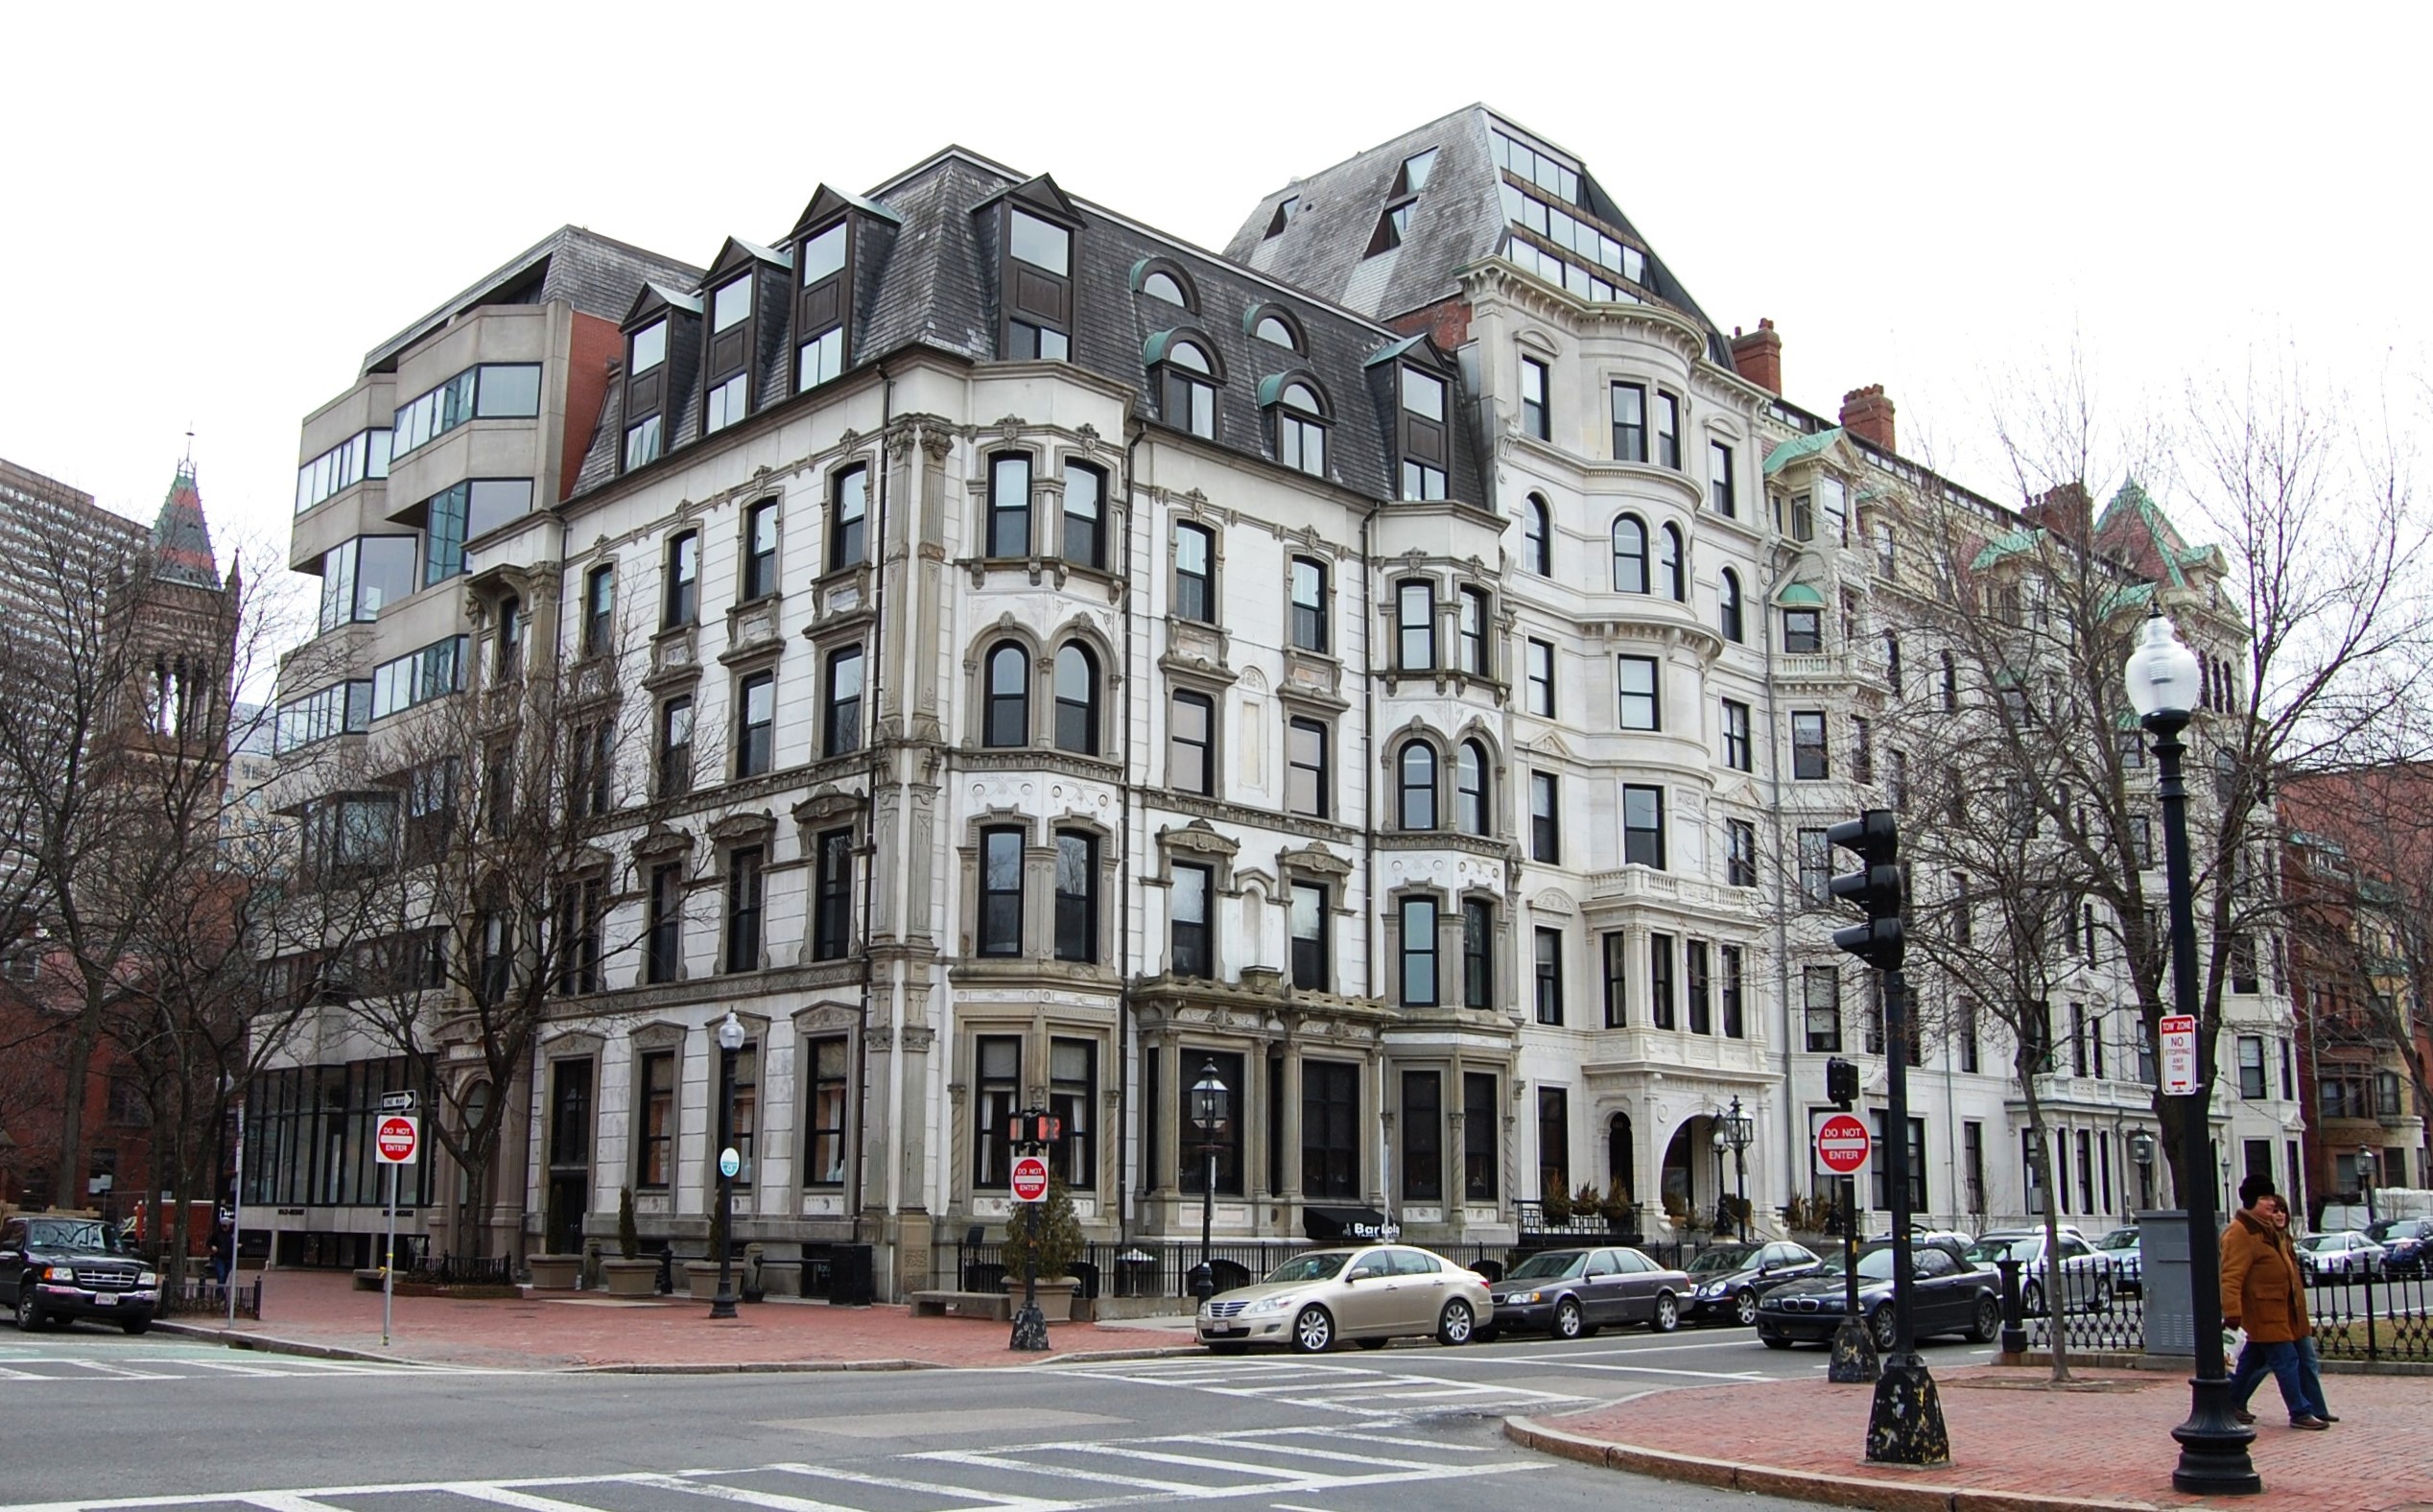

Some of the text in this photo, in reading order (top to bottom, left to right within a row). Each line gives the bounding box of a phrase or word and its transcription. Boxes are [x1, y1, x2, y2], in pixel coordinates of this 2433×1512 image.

[2171, 1036, 2185, 1048] NO
[2165, 1048, 2191, 1056] STOPPING
[384, 1097, 406, 1106] ONE WAY
[1824, 1127, 1861, 1138] DO NOT
[385, 1144, 408, 1152] ENTER
[1829, 1150, 1859, 1160] ENTER
[1354, 1222, 1380, 1235] Bar
